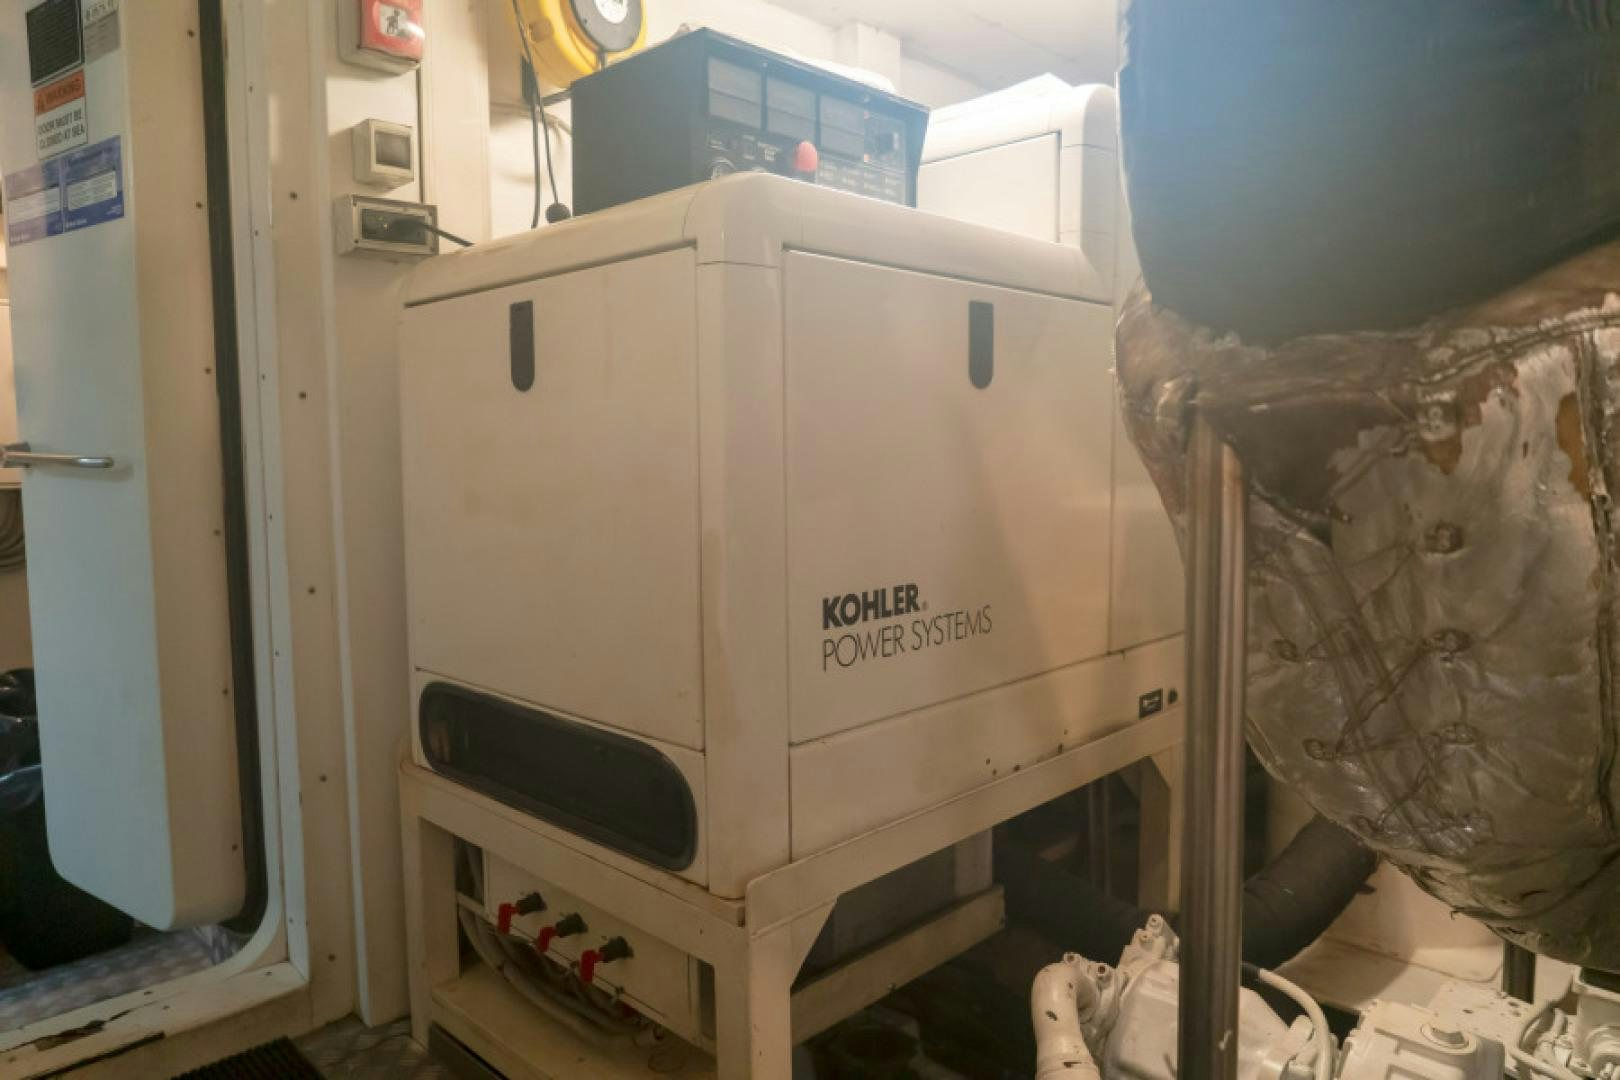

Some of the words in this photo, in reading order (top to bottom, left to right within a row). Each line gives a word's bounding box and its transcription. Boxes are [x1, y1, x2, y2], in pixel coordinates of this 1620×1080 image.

[822, 583, 921, 630] KOHLER
[822, 623, 905, 672] POWER
[911, 604, 992, 651] SYSTEMS
